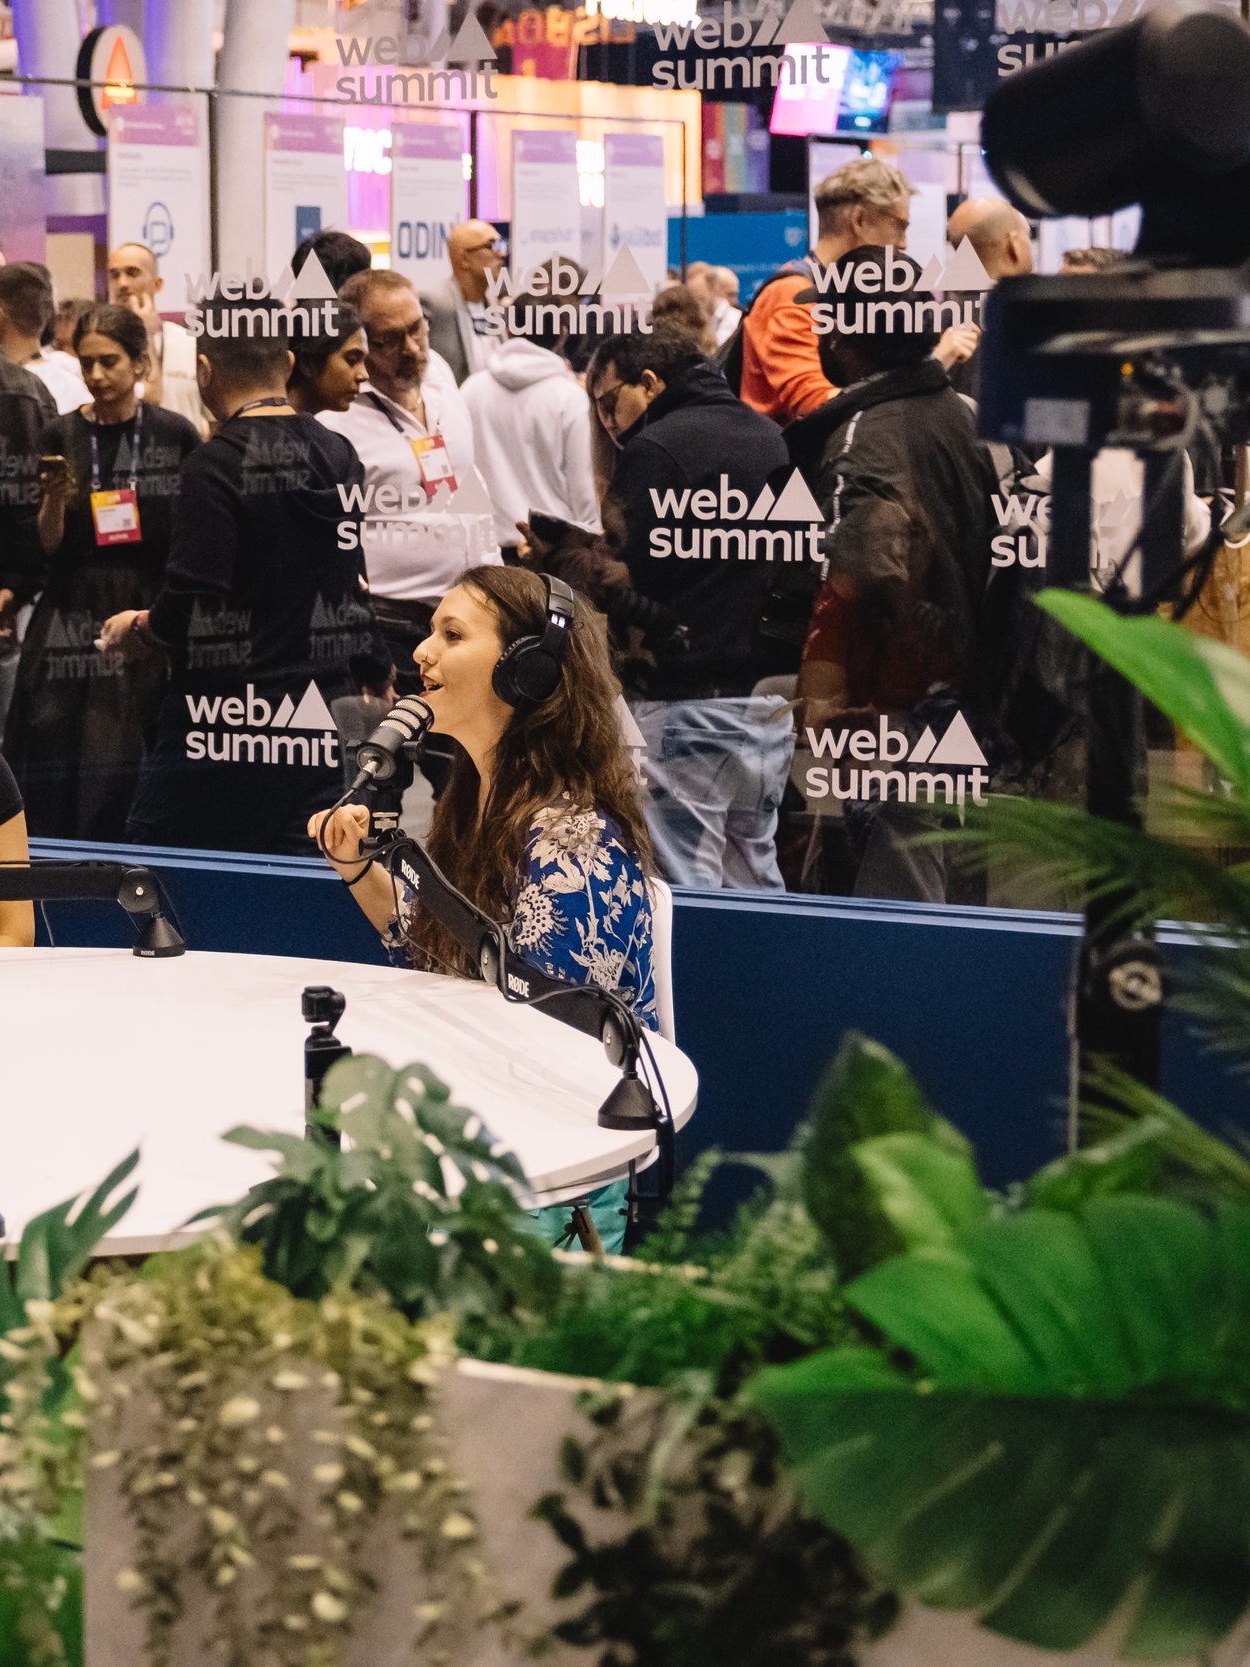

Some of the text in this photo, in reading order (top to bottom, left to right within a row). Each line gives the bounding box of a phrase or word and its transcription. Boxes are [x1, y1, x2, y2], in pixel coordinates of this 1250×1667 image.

[336, 26, 427, 67] web
[652, 1, 752, 51] web
[336, 62, 498, 104] summit
[652, 46, 830, 90] summit
[184, 257, 271, 301] web
[484, 251, 579, 297] web
[810, 245, 915, 293] web
[184, 300, 339, 338] summit
[484, 298, 653, 336] summit
[337, 472, 427, 514] web
[649, 473, 748, 521] web
[337, 517, 496, 553] summit
[649, 523, 826, 563] summit
[185, 683, 272, 727] web
[186, 730, 338, 768] summit
[805, 714, 909, 762] web
[805, 766, 989, 807] summit
[401, 858, 420, 890] RØDE
[507, 973, 530, 998] RØDE
